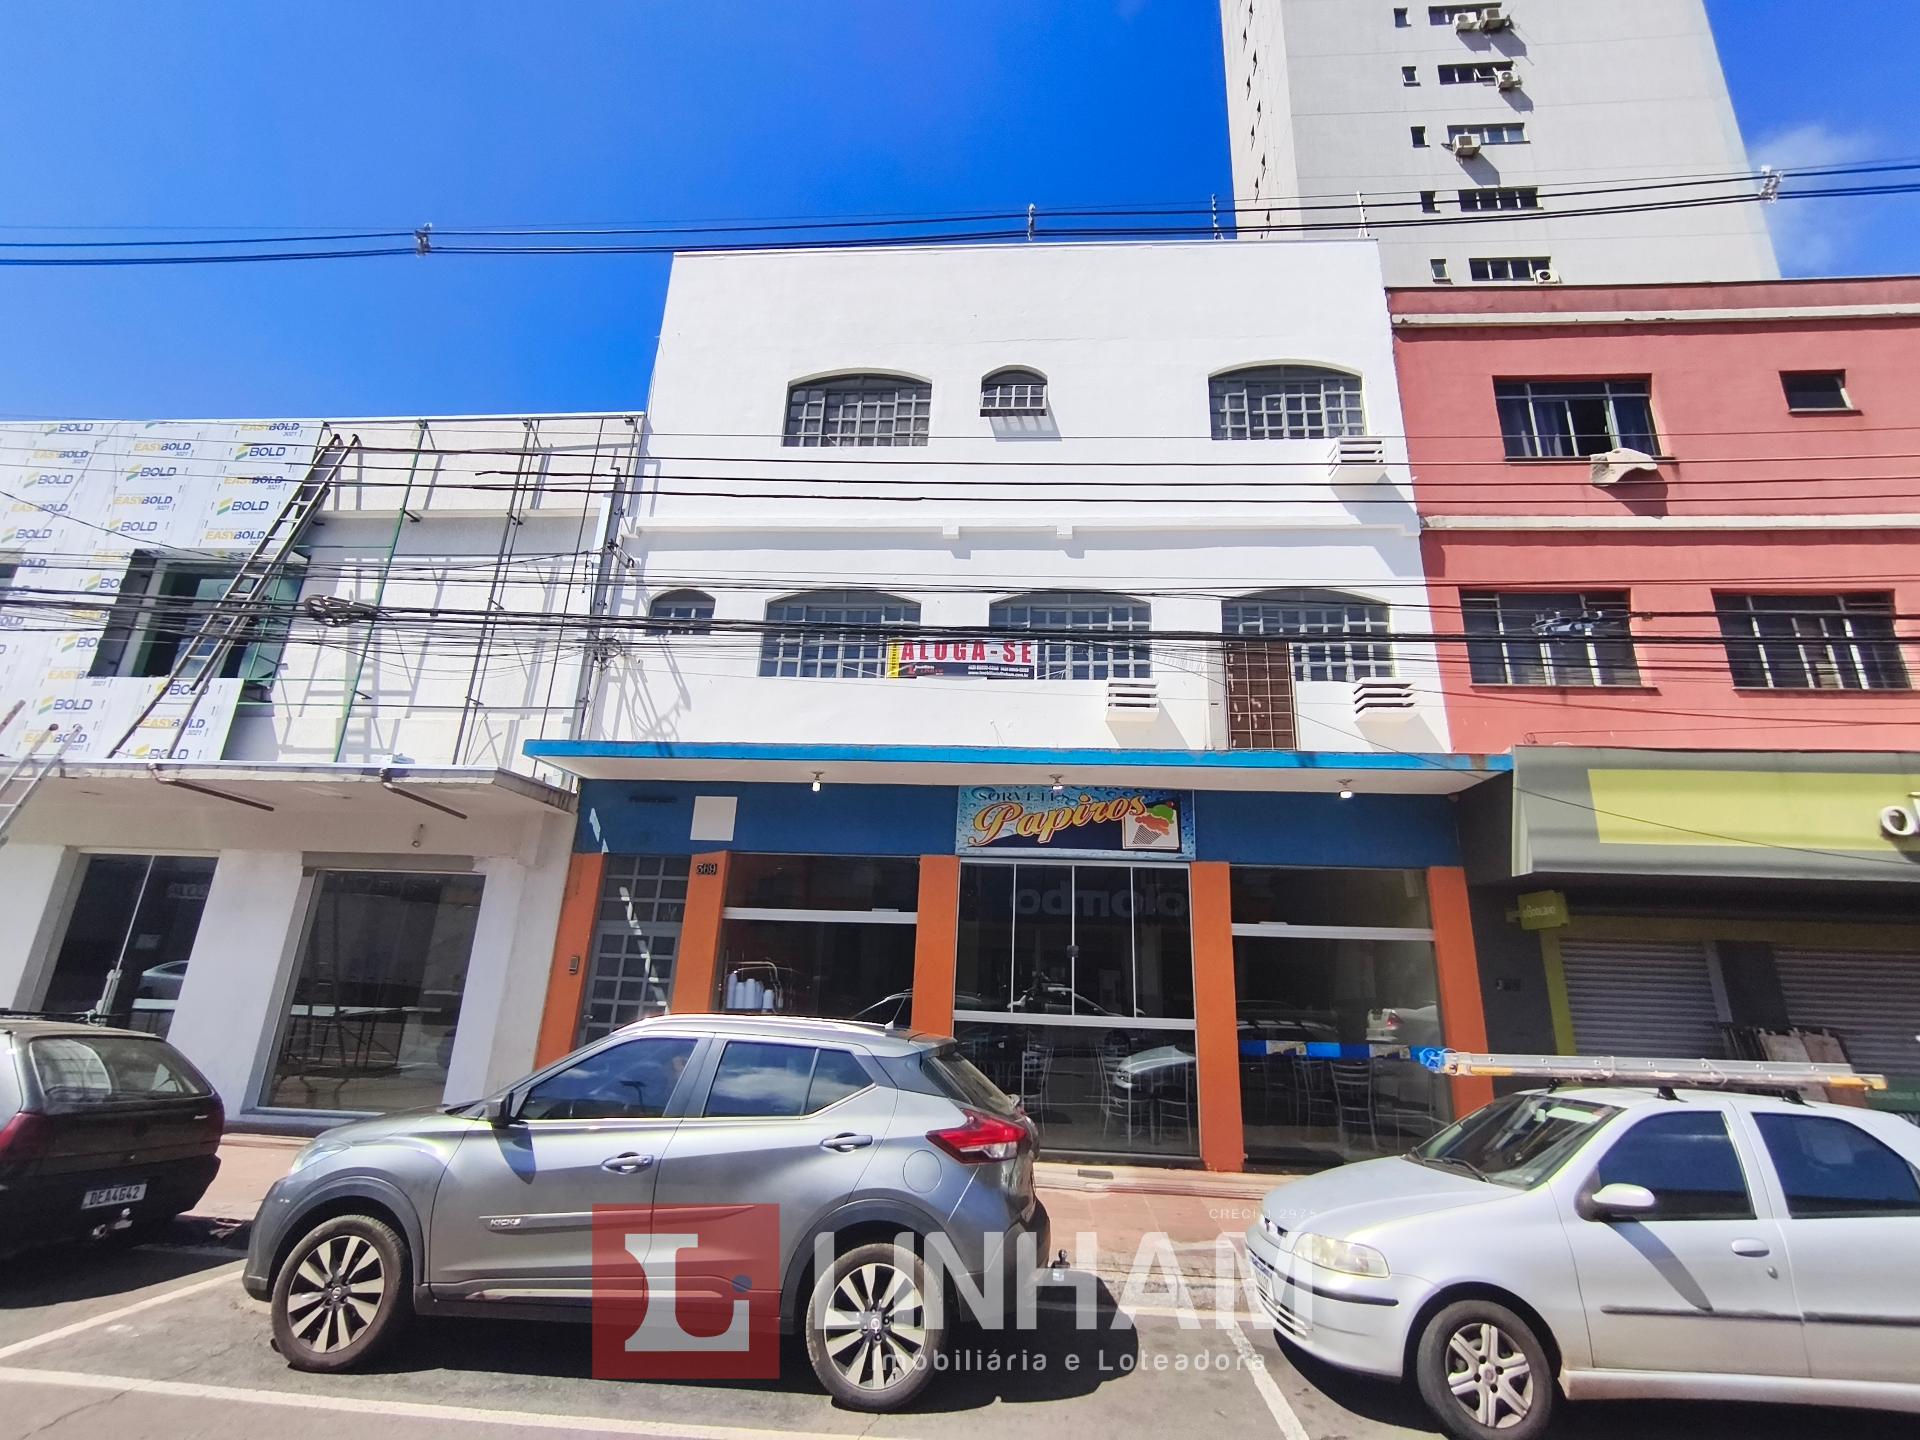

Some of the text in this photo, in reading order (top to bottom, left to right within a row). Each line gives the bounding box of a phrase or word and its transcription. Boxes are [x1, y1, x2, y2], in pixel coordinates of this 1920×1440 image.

[134, 442, 191, 451] EASYBOLD
[249, 447, 286, 456] BOLD
[140, 467, 177, 477] BOLD
[38, 474, 74, 484] BOLD
[113, 495, 172, 504] EASYBOLD
[231, 500, 270, 510] BOLD
[120, 522, 157, 532] BOLD
[16, 529, 52, 538] BOLD
[205, 530, 266, 540] EASYBOLD
[53, 698, 92, 710] BOLD
[967, 793, 1147, 847] Papiros
